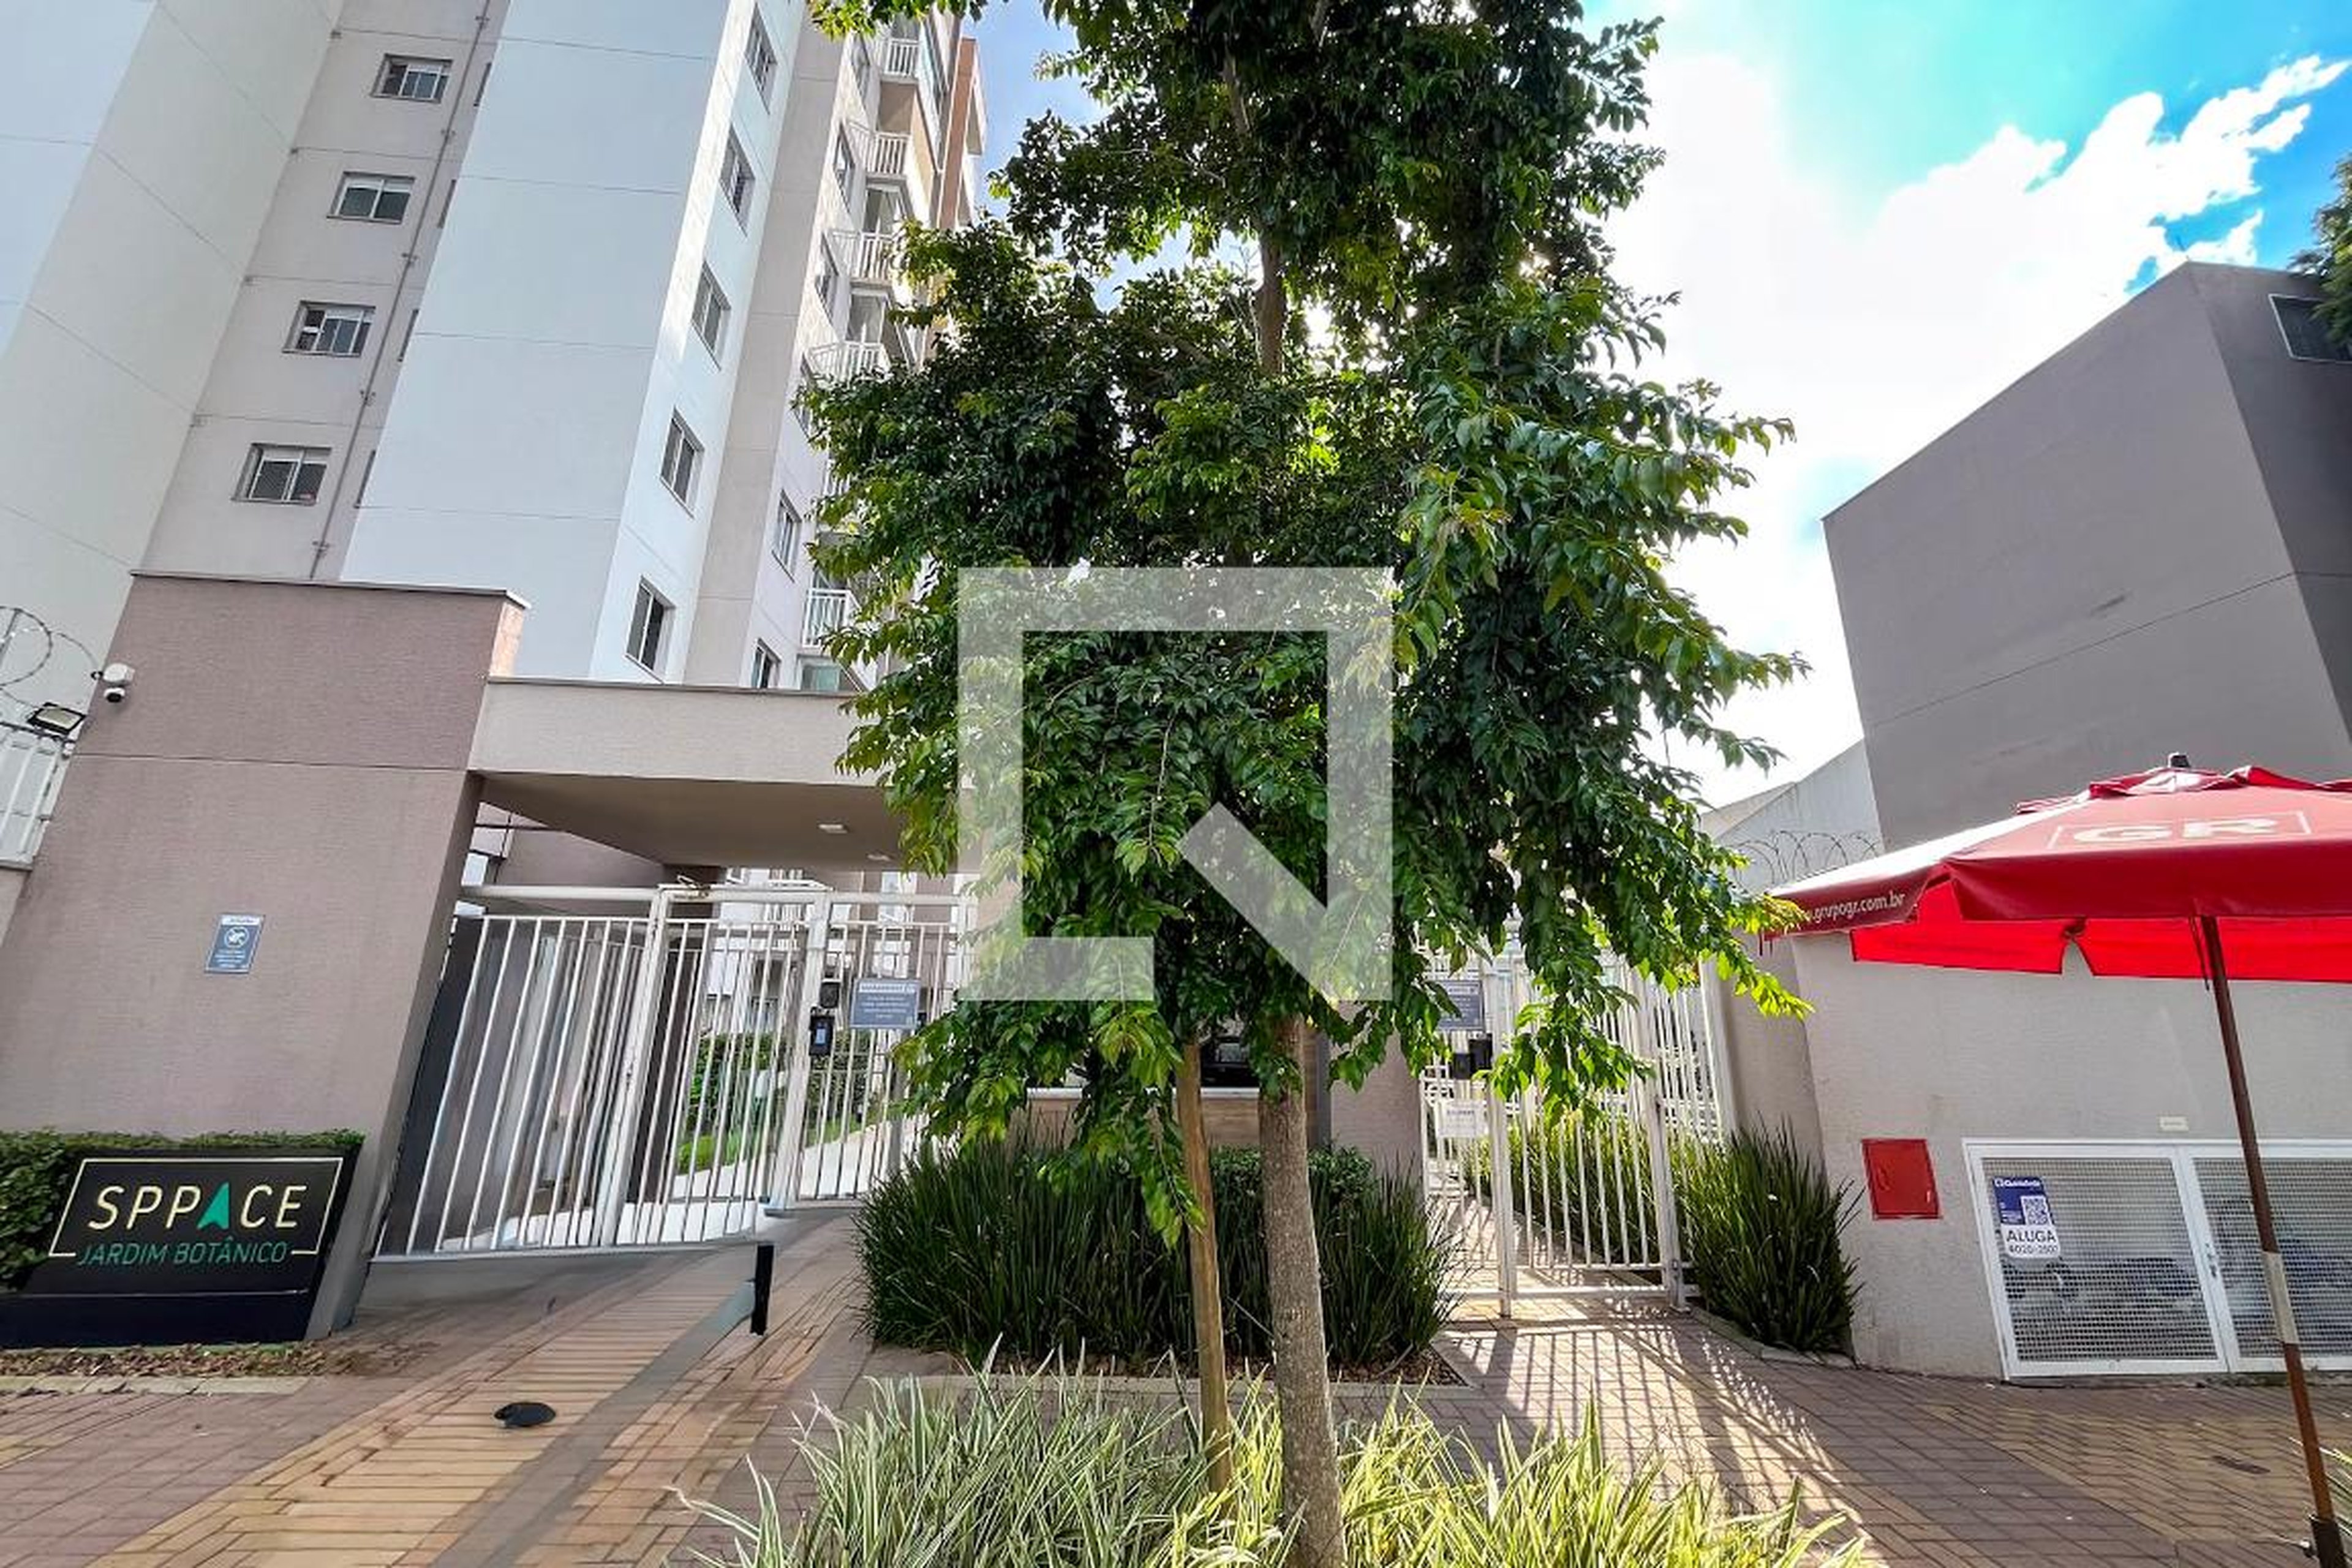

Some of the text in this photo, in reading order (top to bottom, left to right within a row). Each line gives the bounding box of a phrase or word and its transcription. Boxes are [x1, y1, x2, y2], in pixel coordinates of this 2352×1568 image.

[2073, 818, 2278, 843] GR
[88, 1182, 307, 1230] SPPACE
[77, 1235, 288, 1266] JARDIM BOTÂNICO
[2007, 1230, 2057, 1243] ALUGA
